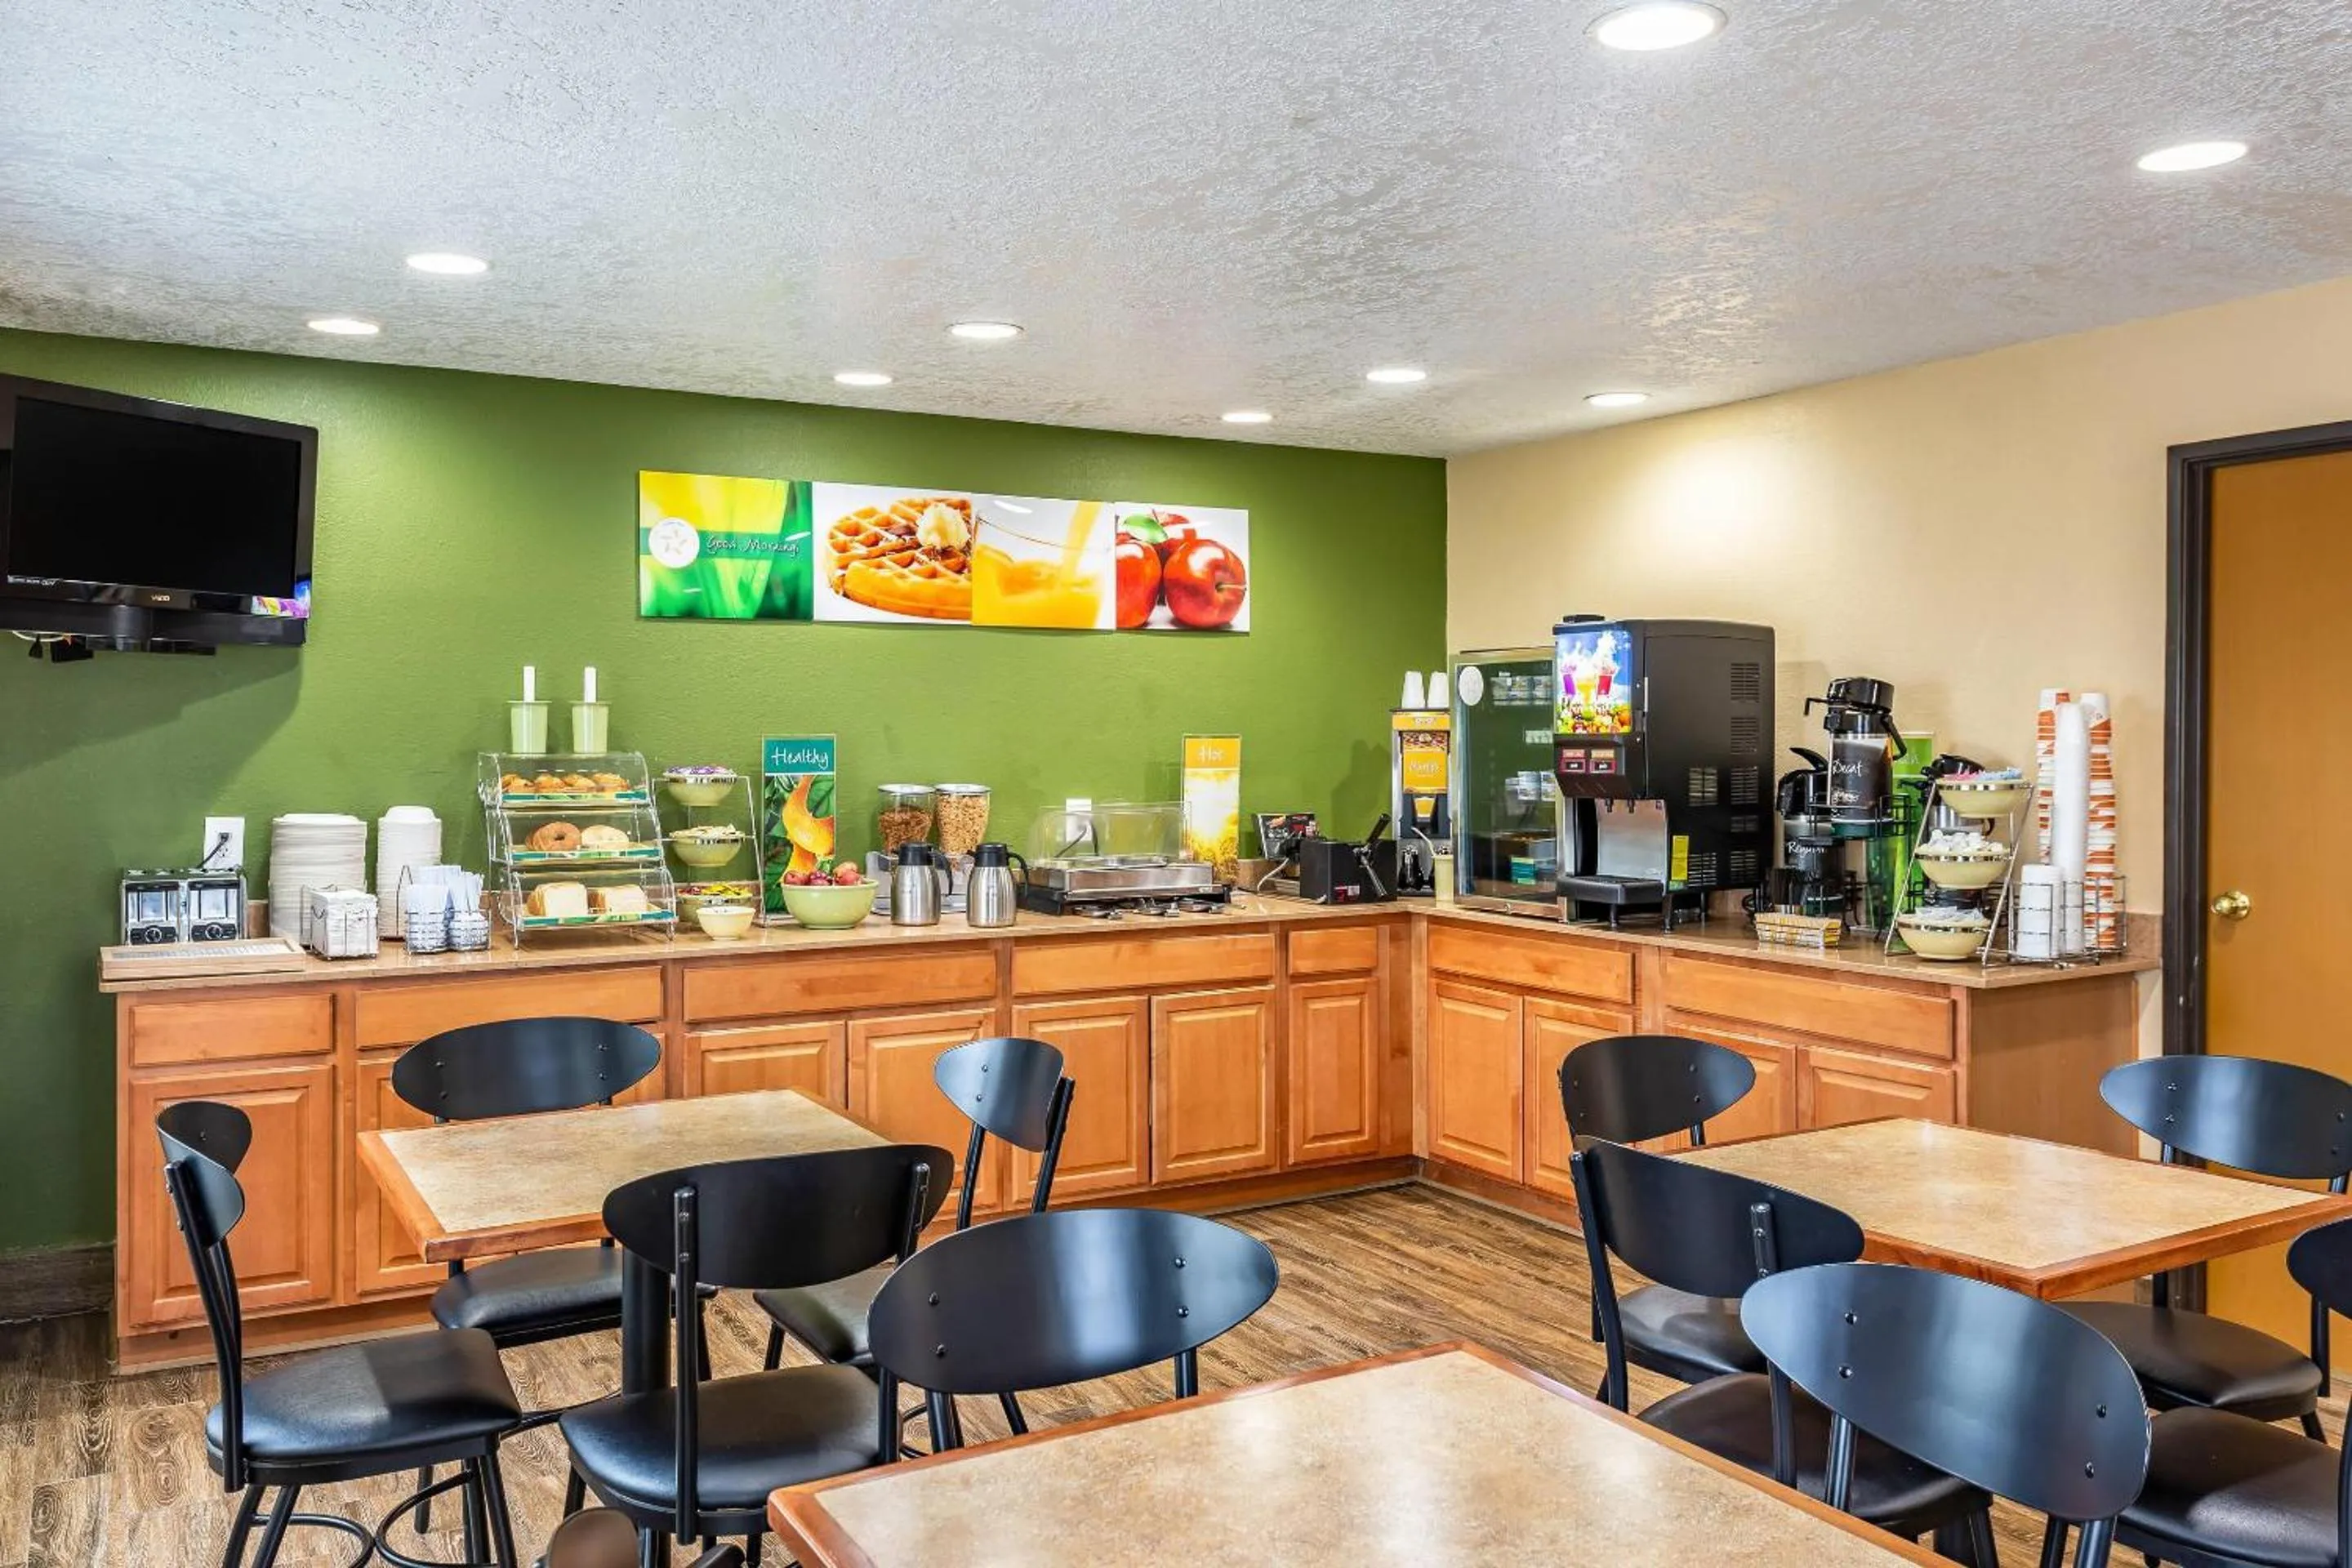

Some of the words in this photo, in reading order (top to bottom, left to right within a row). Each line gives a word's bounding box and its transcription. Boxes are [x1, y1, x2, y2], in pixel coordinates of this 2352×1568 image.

[706, 535, 737, 555] Good
[771, 746, 829, 770] Healthy
[1832, 758, 1863, 777] Decaf
